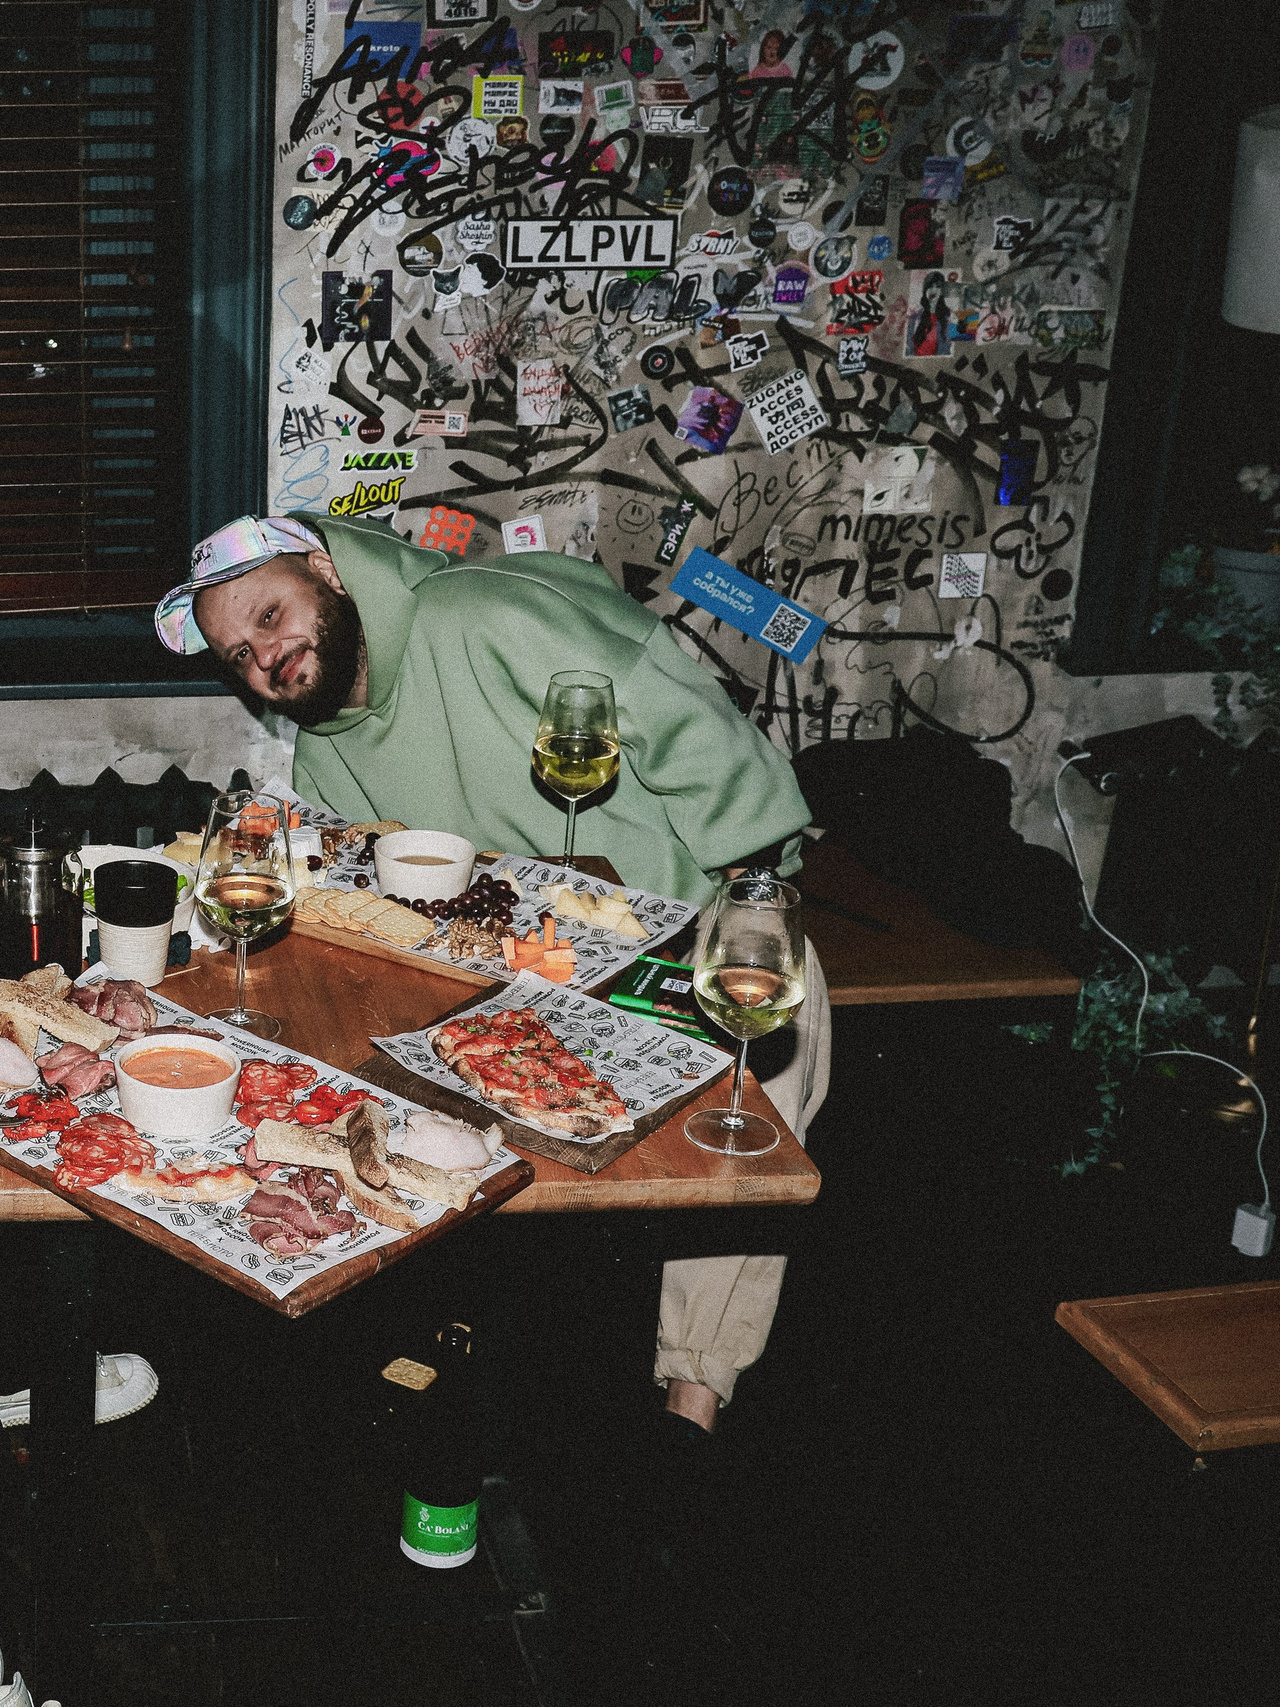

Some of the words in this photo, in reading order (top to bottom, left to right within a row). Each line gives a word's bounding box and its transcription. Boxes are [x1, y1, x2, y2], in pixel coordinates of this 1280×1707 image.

[306, 0, 316, 30] OLLY
[301, 34, 315, 97] RESONANCE
[510, 224, 666, 264] LZLPVL
[777, 280, 806, 291] RAW
[748, 370, 805, 409] ZUGANG
[759, 385, 804, 416] ACCES
[766, 405, 819, 441] ACCESS
[770, 414, 825, 454] ДОСТУП
[329, 476, 406, 516] SELLOUT
[817, 509, 971, 549] mimesis
[692, 578, 755, 616] собрался?
[705, 571, 713, 580] а
[715, 576, 731, 589] ты
[730, 585, 754, 604] уже
[150, 998, 178, 1014] ERHOUSE
[228, 1034, 271, 1055] POWERHOUSE
[231, 1042, 258, 1056] MOSCOW
